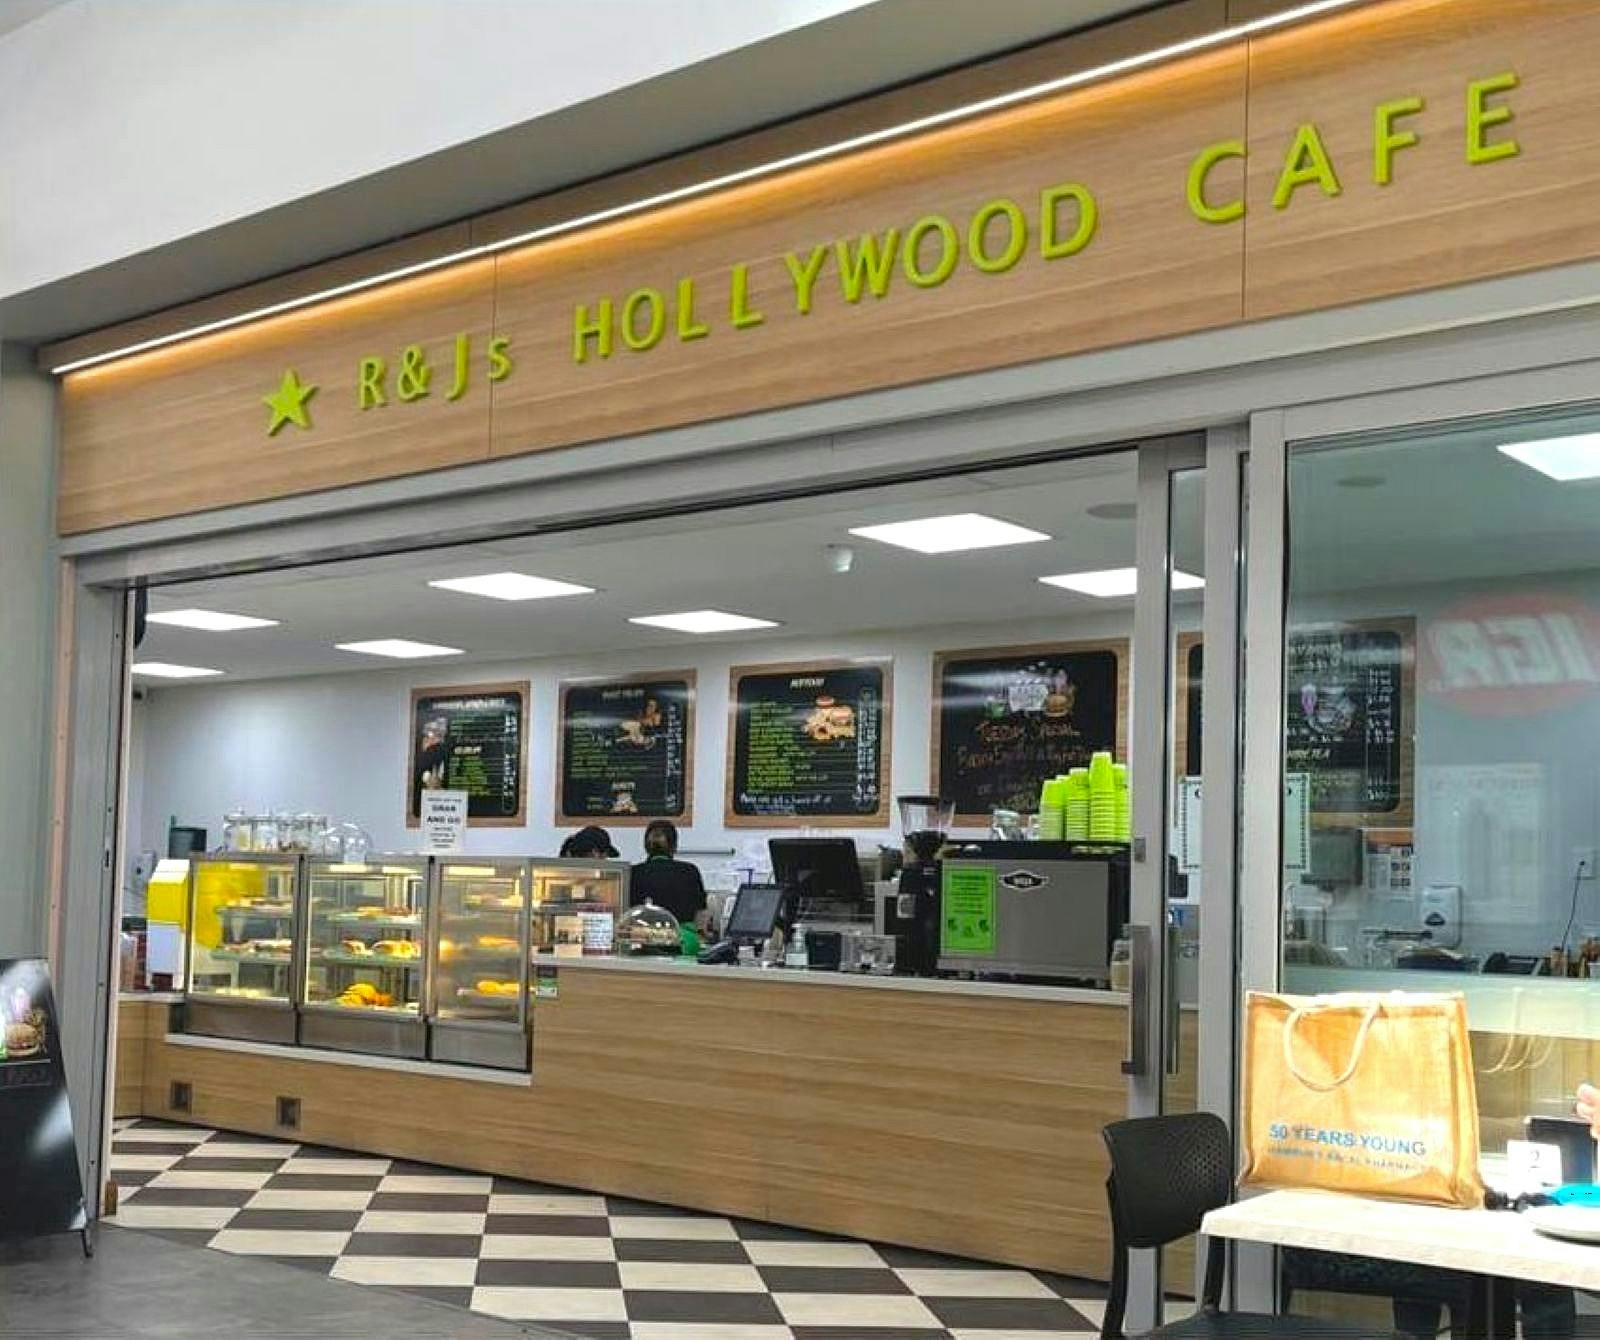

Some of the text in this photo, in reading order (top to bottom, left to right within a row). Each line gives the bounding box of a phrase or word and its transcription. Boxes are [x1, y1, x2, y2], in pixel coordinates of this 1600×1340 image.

[359, 72, 1519, 408] R&Js HOLLYWOOD CAFE
[426, 815, 446, 823] AND
[1268, 1122, 1427, 1156] 50 YEARS YOUNG
[1529, 1149, 1541, 1169] 2
